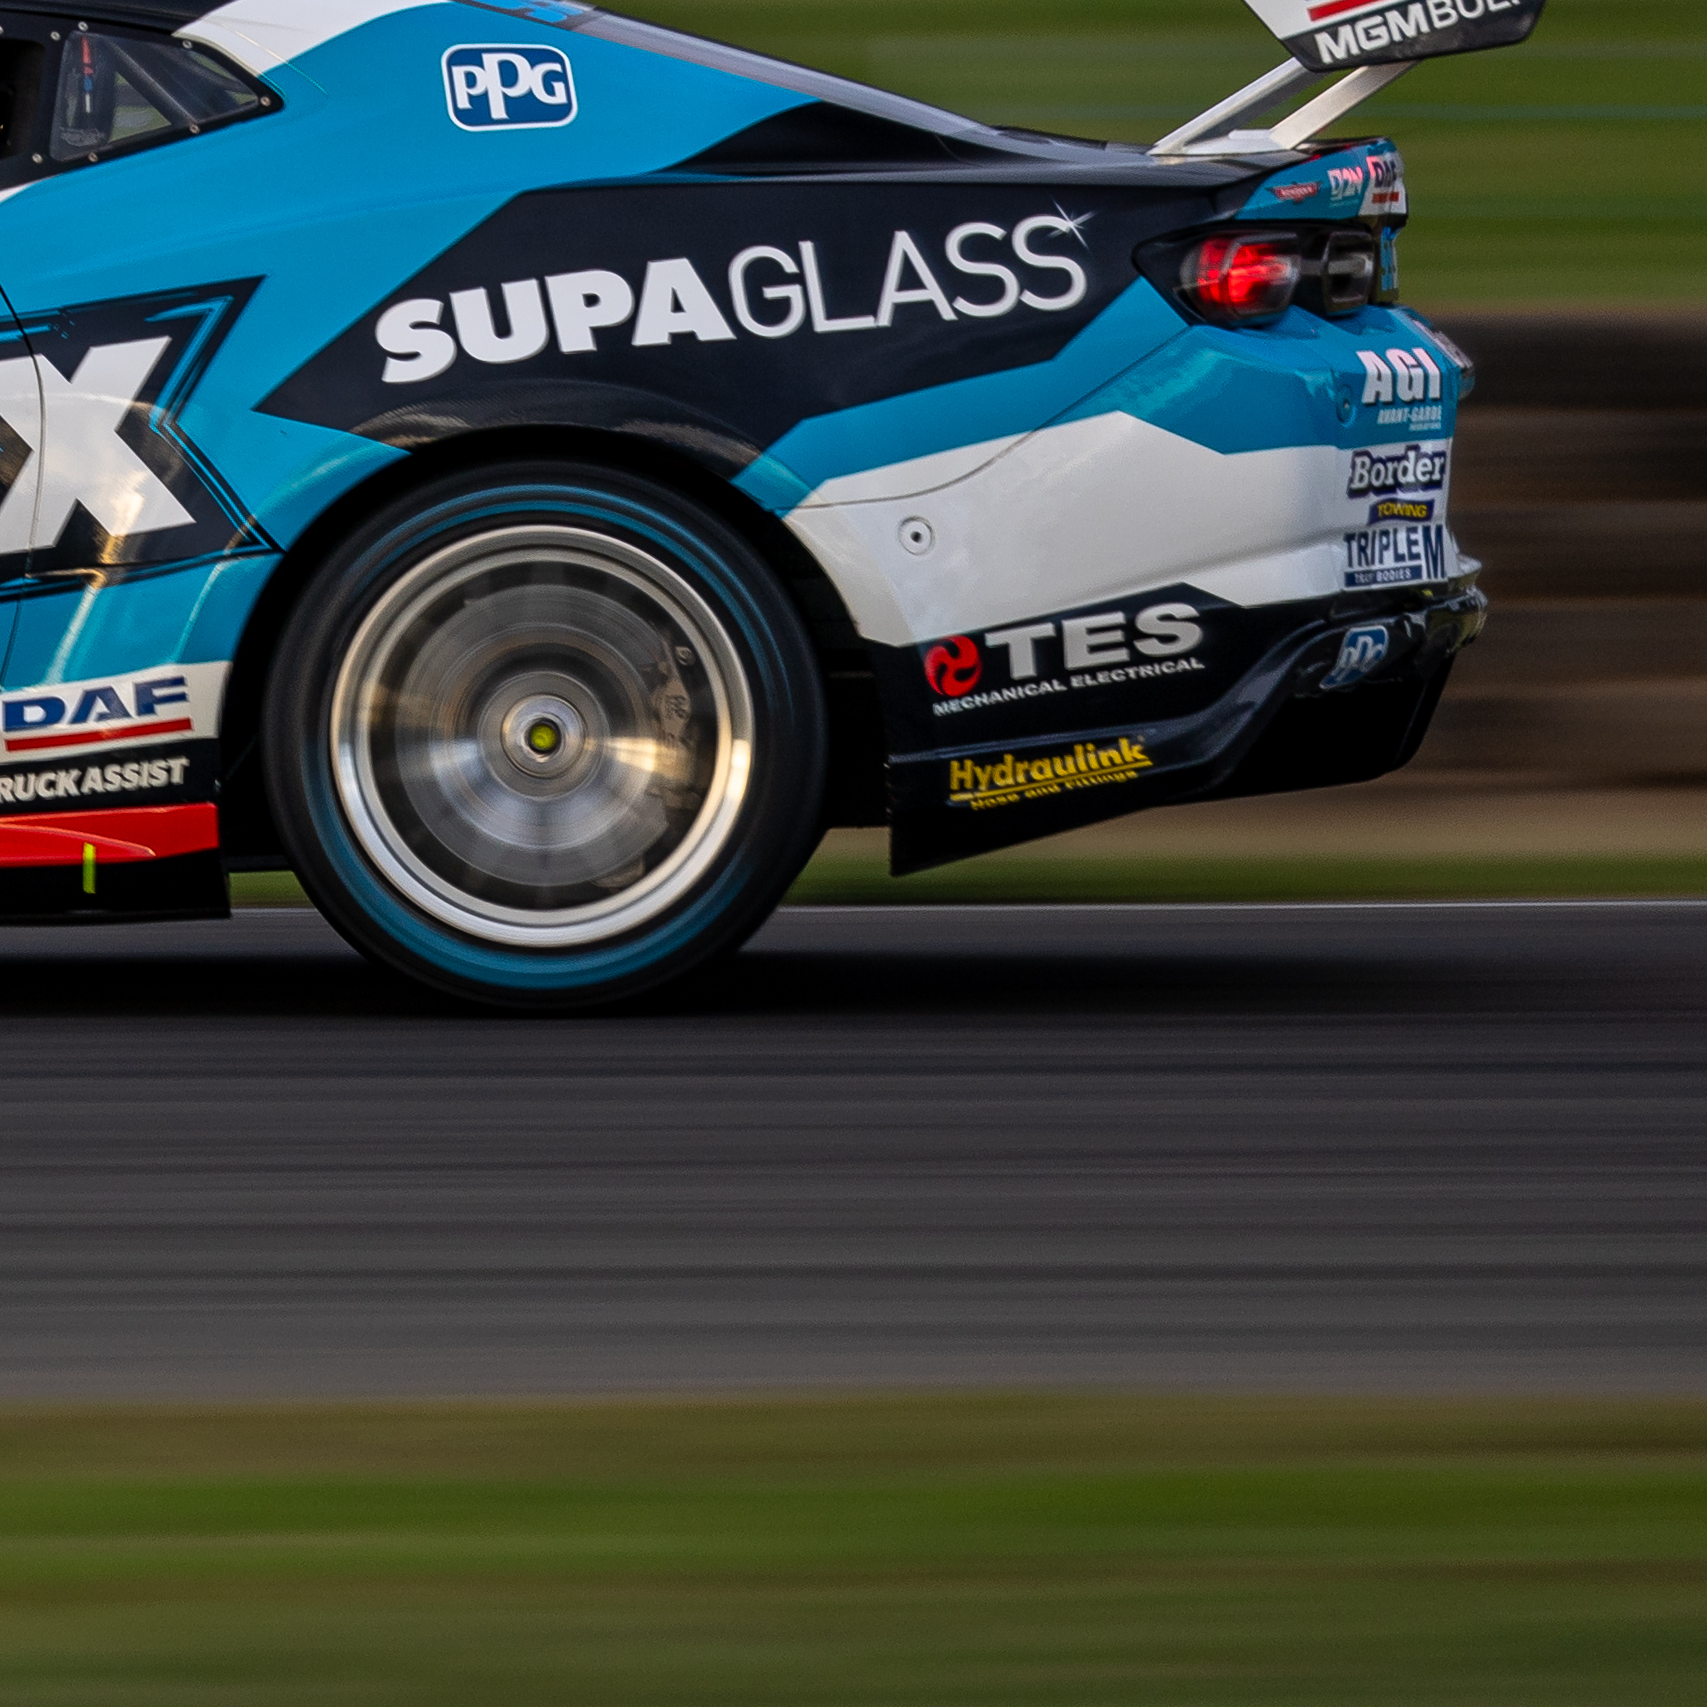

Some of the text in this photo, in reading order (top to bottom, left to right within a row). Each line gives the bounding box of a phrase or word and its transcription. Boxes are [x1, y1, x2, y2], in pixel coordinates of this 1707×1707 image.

[452, 53, 567, 119] PPG
[375, 215, 1088, 383] SUPAGLASS
[1349, 450, 1445, 489] Border
[1378, 502, 1427, 518] TOWING
[1344, 524, 1445, 579] TRIPLE M
[984, 602, 1204, 681] TES
[2, 676, 188, 732] DAF
[933, 656, 1205, 717] MECHANICAL ELECTRICAL
[950, 737, 1149, 791] Hydraulink
